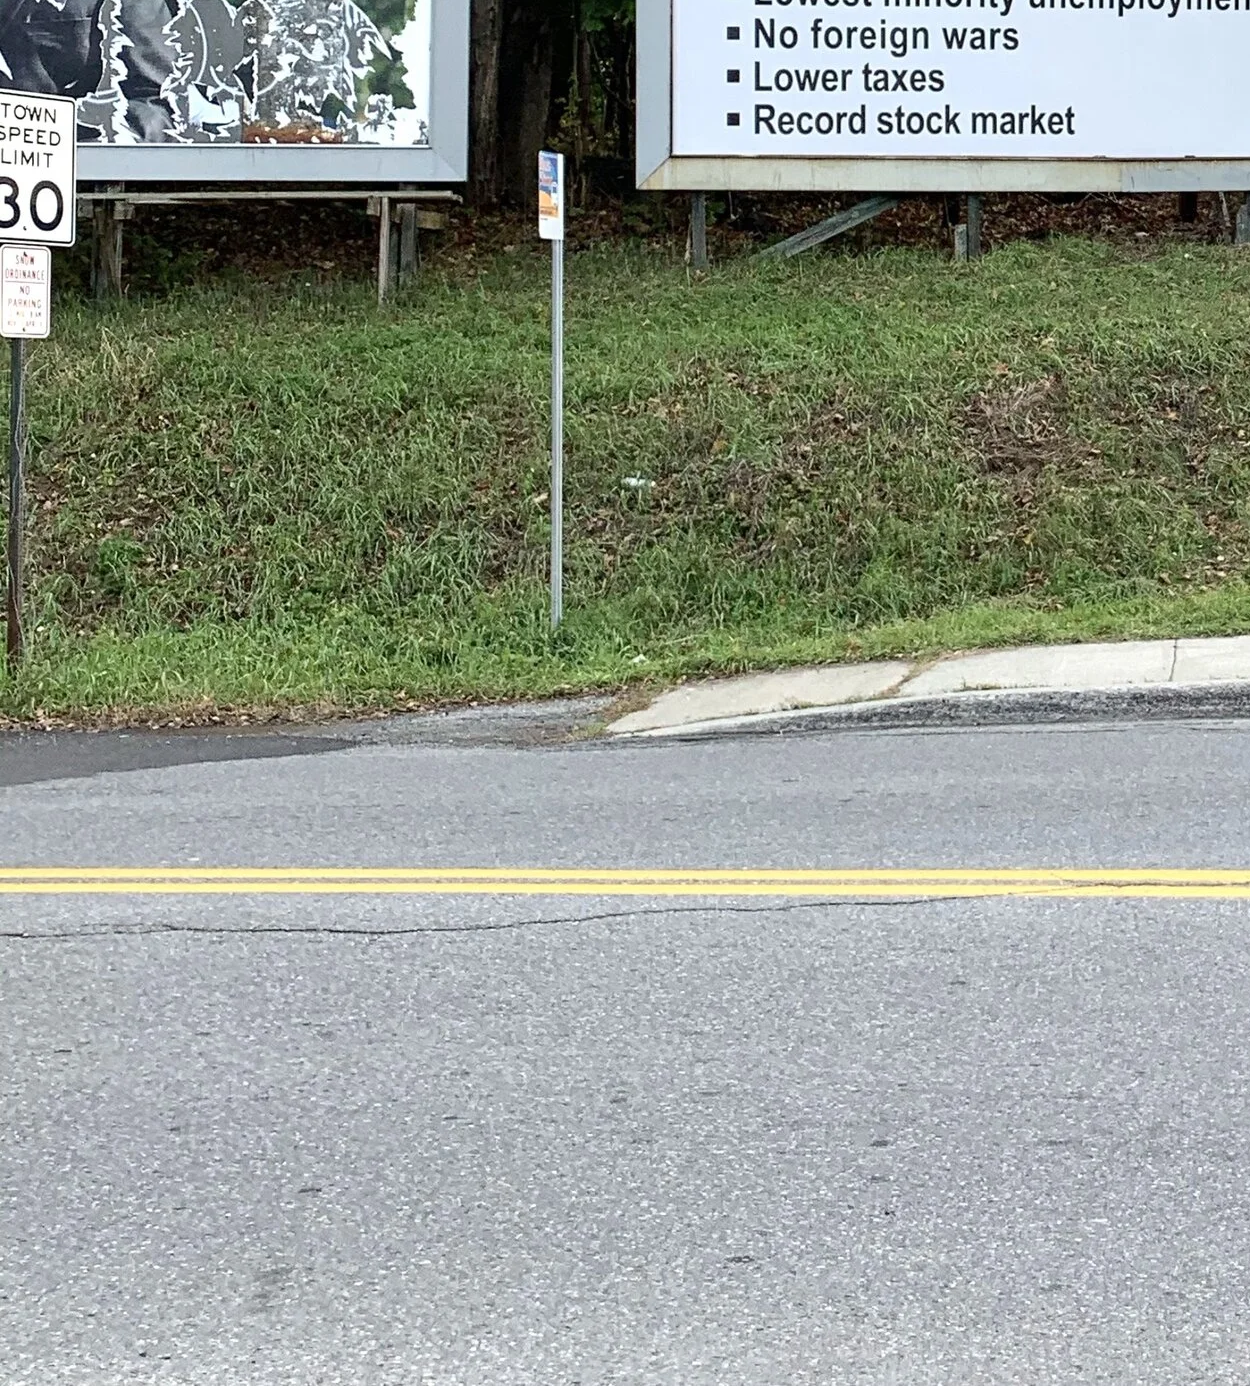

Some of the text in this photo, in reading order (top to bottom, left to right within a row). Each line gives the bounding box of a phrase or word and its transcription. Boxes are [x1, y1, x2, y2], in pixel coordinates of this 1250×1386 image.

[754, 17, 1019, 58] No foreign wars
[754, 60, 945, 93] Lower taxes
[1, 102, 56, 124] TOWN
[754, 103, 1076, 136] Record stock market
[0, 125, 61, 146] SPEED
[1, 148, 53, 168] LIMIT
[0, 176, 64, 231] 30
[15, 254, 35, 266] SNOW
[5, 268, 45, 281] ORDINANCE
[19, 285, 31, 296] NO
[7, 298, 42, 309] PARKING
